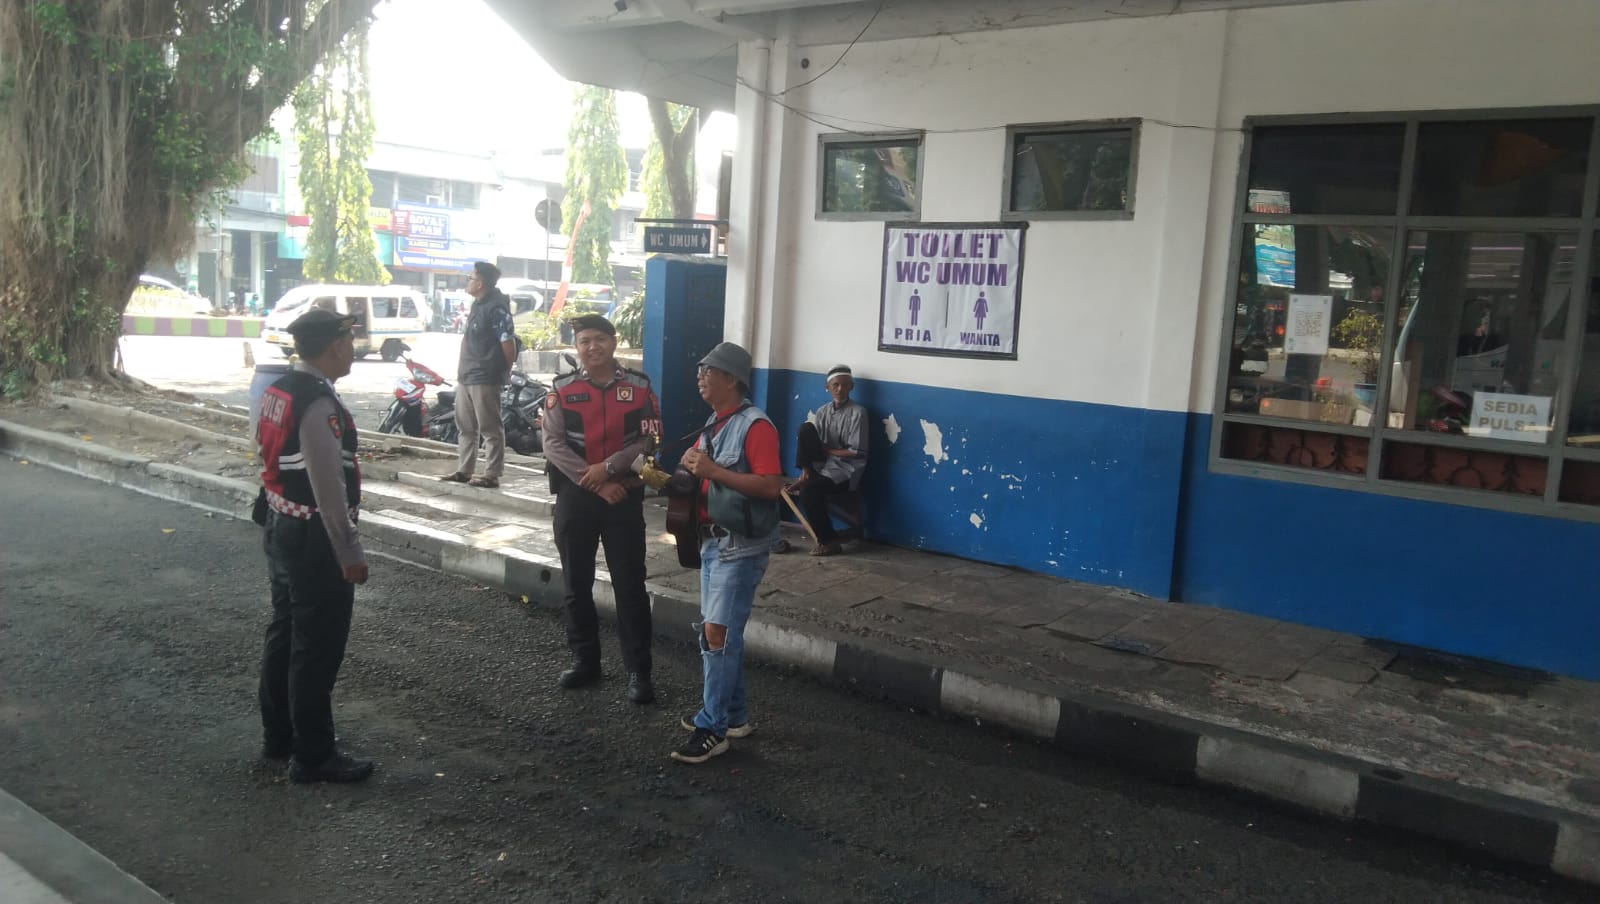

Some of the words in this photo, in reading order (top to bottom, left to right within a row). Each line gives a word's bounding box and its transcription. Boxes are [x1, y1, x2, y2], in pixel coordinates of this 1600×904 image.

[650, 233, 664, 246] WC
[669, 233, 698, 247] UMUM
[904, 233, 1004, 258] TOILET
[896, 261, 931, 284] WC
[936, 262, 1008, 286] UMUM
[894, 328, 932, 342] PRIA
[960, 331, 1001, 346] WANITA
[1483, 400, 1538, 416] SEDIA
[641, 419, 661, 435] PAT
